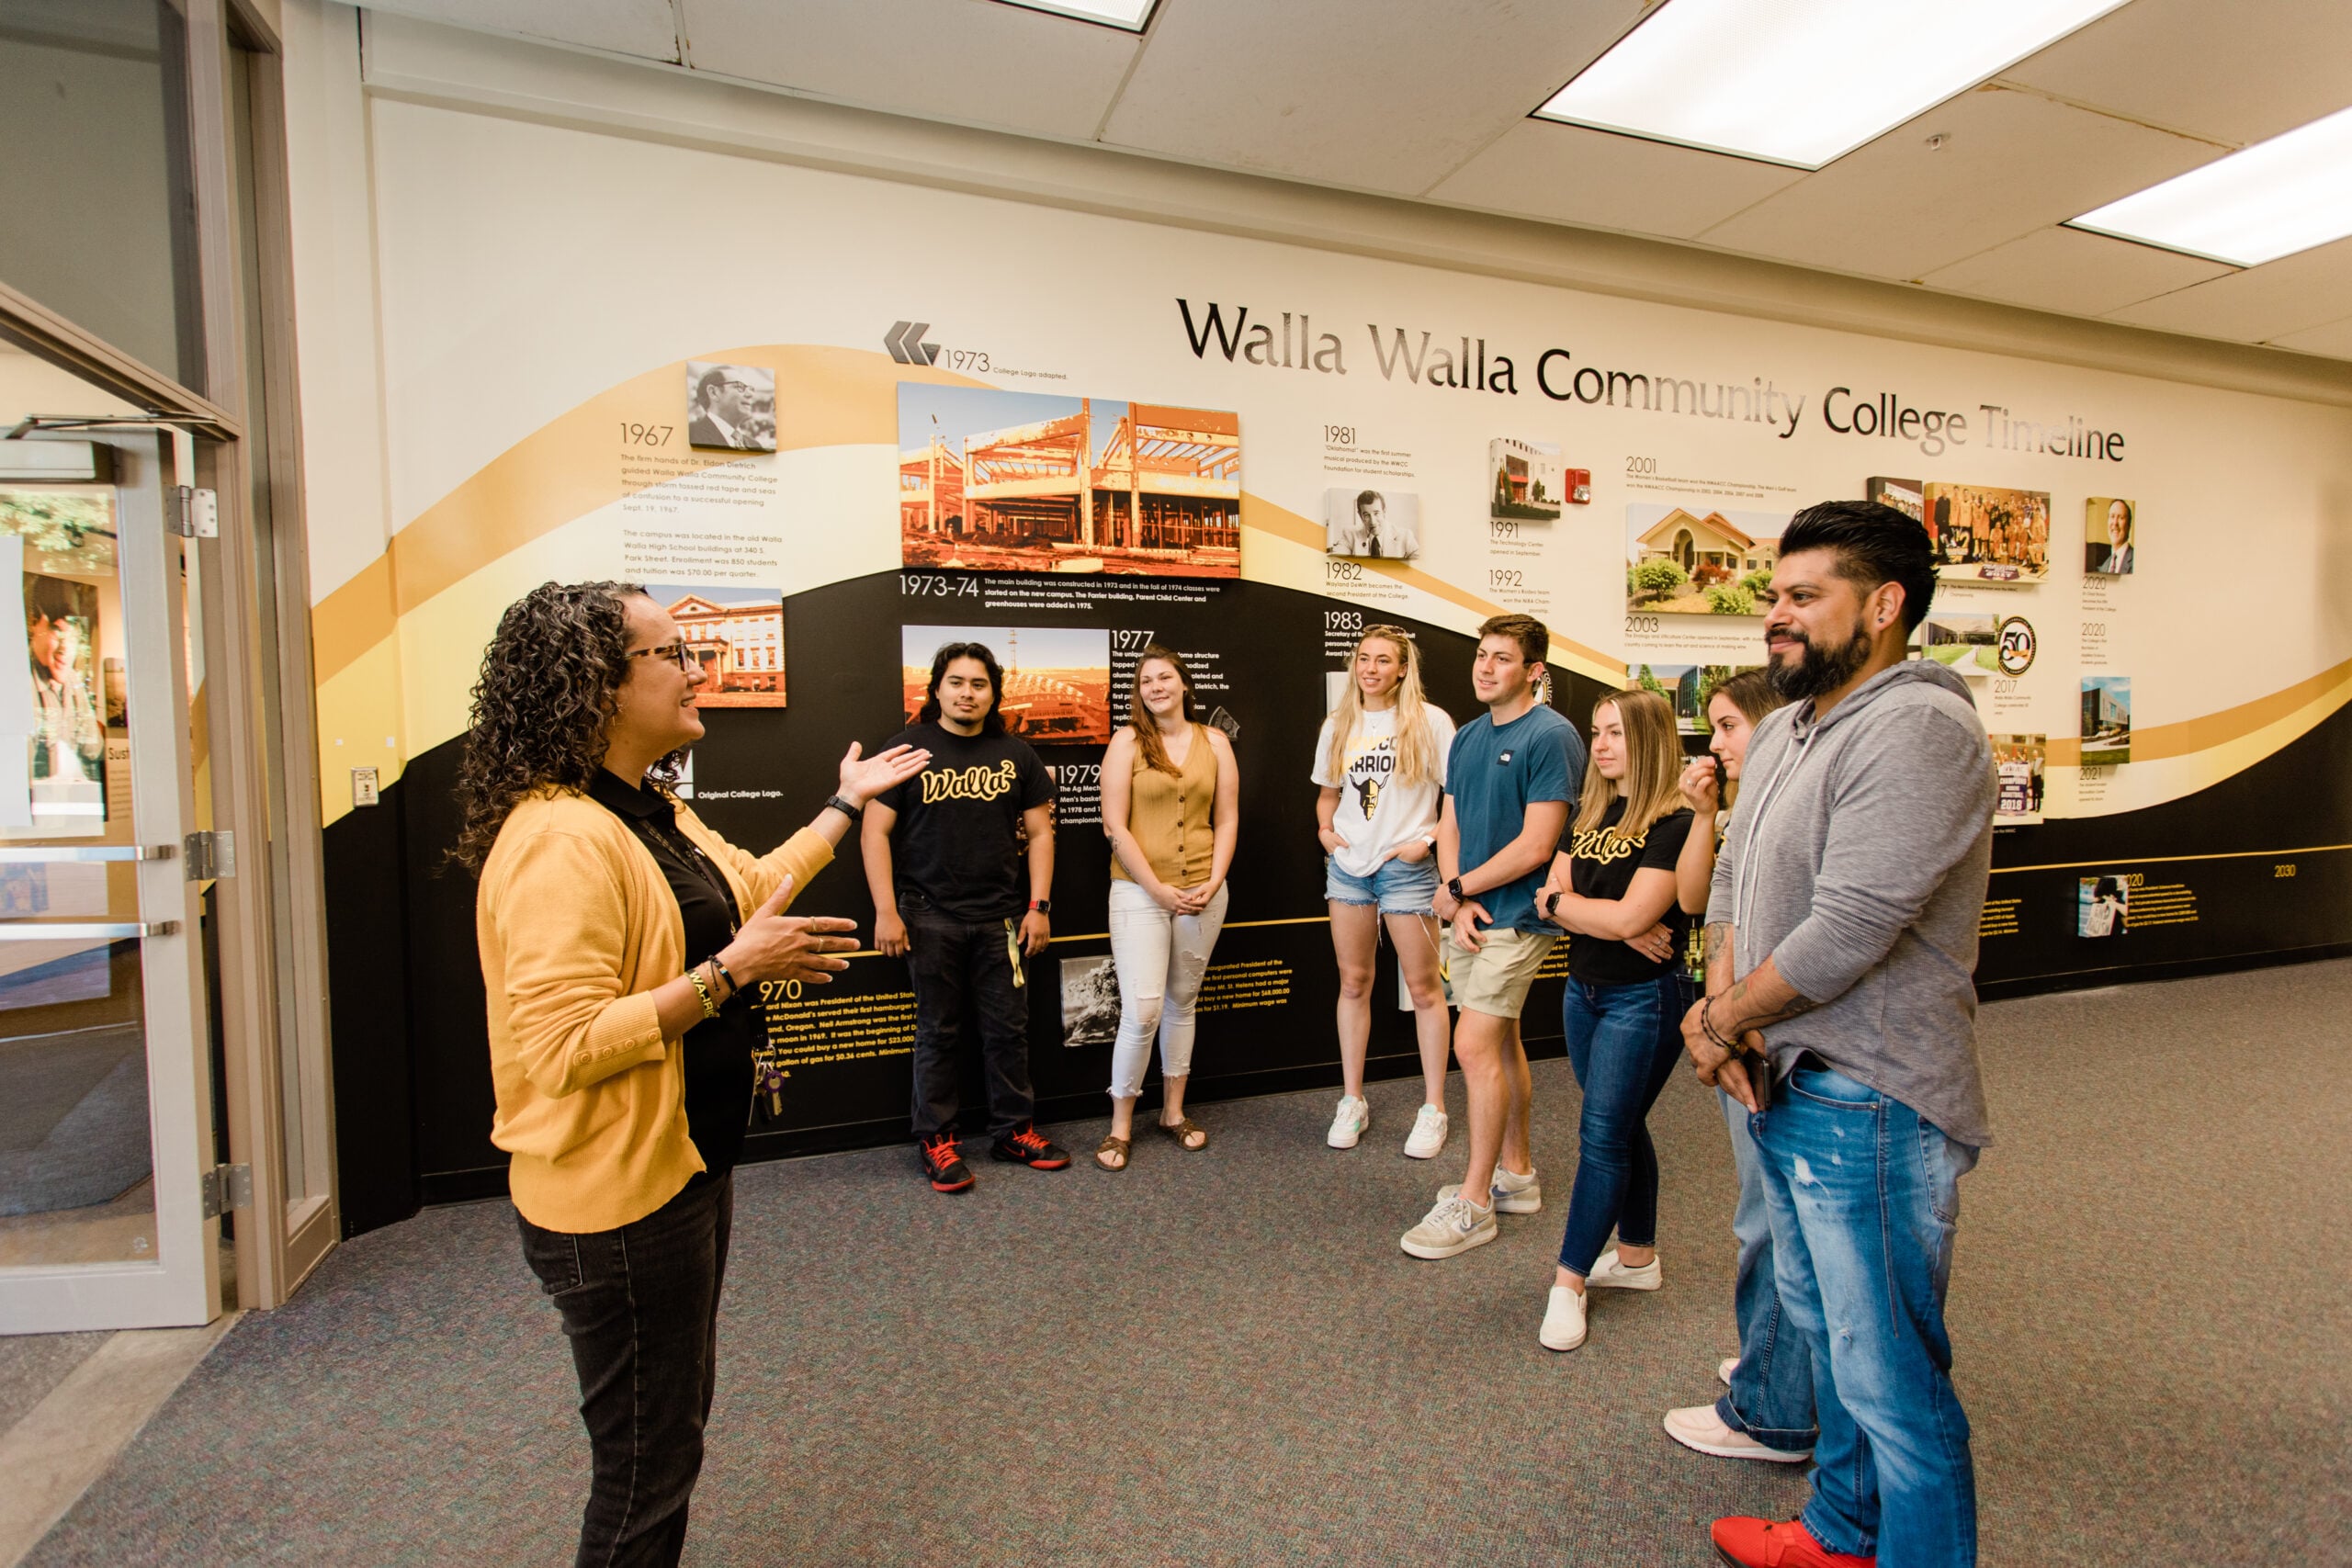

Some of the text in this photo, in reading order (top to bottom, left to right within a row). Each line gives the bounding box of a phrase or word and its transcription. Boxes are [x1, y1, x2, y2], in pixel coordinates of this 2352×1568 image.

[945, 350, 989, 372] 1973
[994, 367, 1019, 376] College
[1176, 298, 2124, 463] Walla Walla Community College Timeline
[621, 423, 673, 446] 1967
[1325, 425, 1355, 444] 1981
[1626, 457, 1657, 473] 2001
[622, 479, 652, 488] through
[701, 472, 745, 480] Community
[748, 475, 777, 483] College
[1490, 522, 1518, 538] 1991
[1326, 562, 1362, 580] 1982
[1490, 570, 1521, 586] 1992
[899, 575, 979, 597] 1973-74
[1016, 579, 1042, 587] building
[2083, 576, 2107, 590] 2020
[1937, 584, 1948, 598] 17
[1324, 612, 1363, 630] 1983
[1625, 616, 1658, 632] 2003
[2082, 623, 2106, 636] 2020
[1112, 630, 1154, 649] 1977
[1995, 680, 2018, 693] 2017
[1058, 764, 1102, 784] 1979
[2080, 767, 2102, 780] 2021
[698, 790, 784, 800] Original College Logo.
[2001, 799, 2022, 810] 2018
[2275, 864, 2296, 877] 2030
[2125, 873, 2144, 886] 020
[759, 979, 801, 1001] 970
[820, 996, 853, 1005] President
[773, 1011, 816, 1021] McDonald's
[818, 1009, 842, 1017] served
[879, 1048, 910, 1056] Minimum
